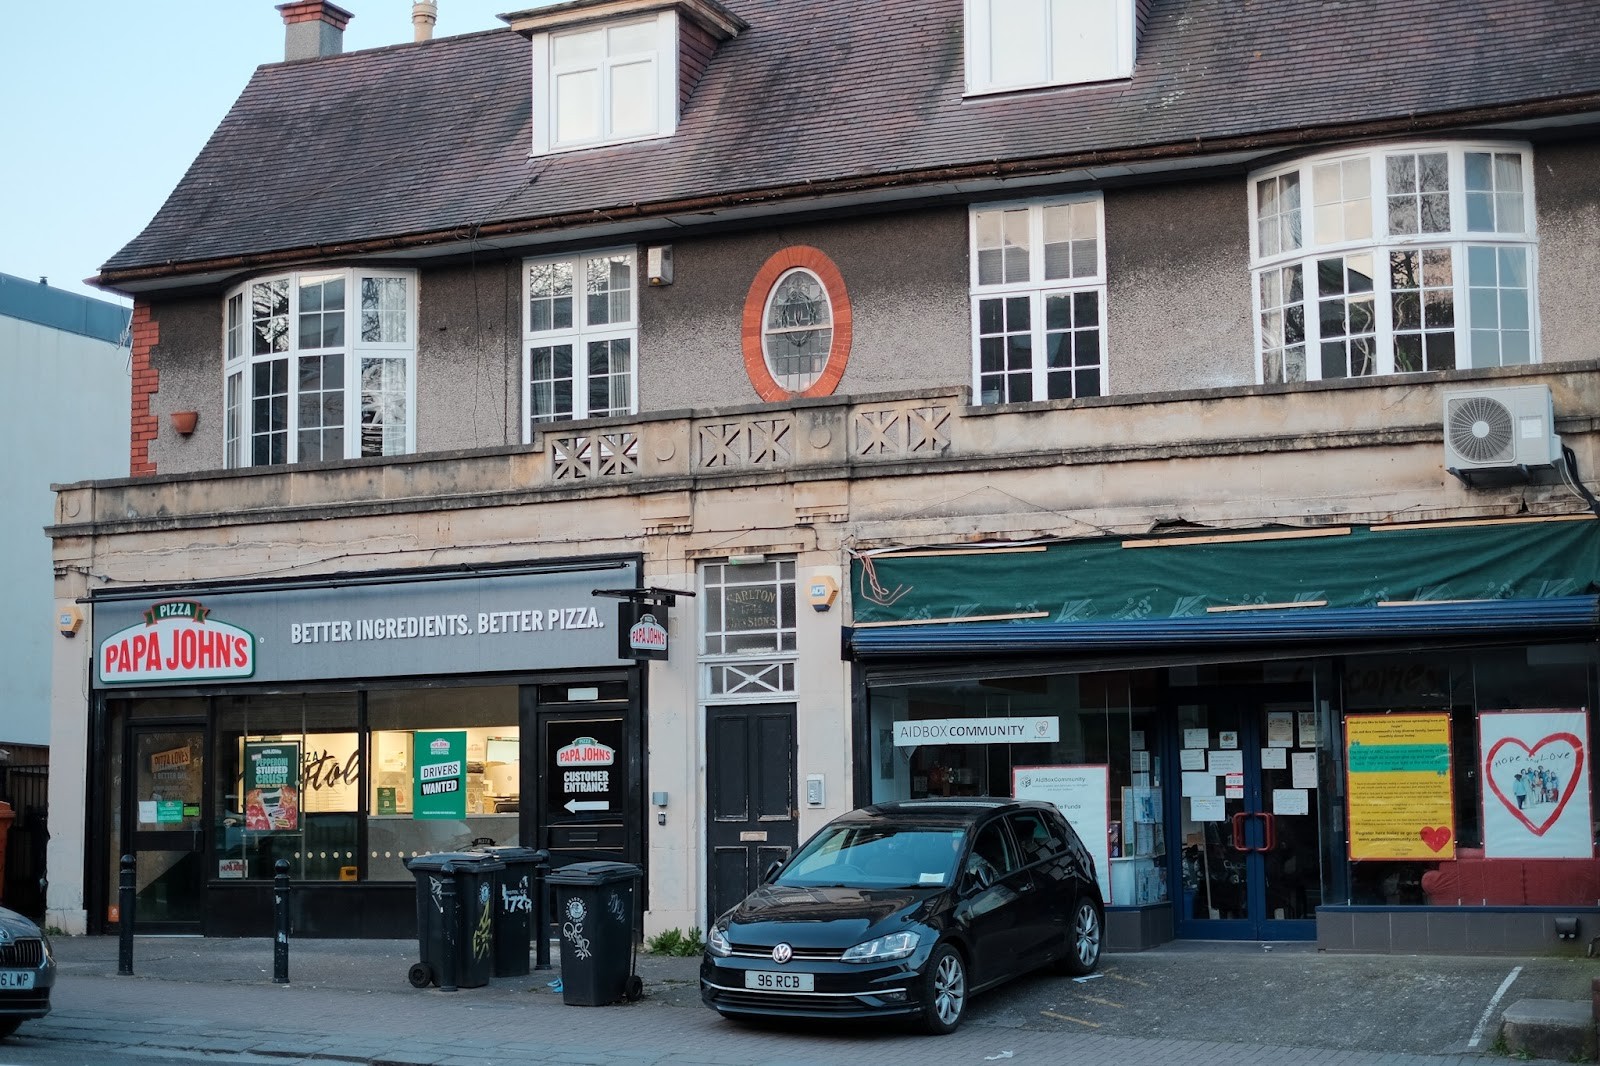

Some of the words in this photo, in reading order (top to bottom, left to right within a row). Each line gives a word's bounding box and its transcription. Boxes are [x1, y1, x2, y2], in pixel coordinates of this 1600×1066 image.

[726, 589, 776, 604] CARLTON
[160, 603, 191, 617] PIZZA
[291, 621, 353, 644] BETTER
[357, 614, 473, 641] INGREDIENTS.
[477, 610, 543, 634] BETTER
[548, 607, 604, 629] PIZZA.
[632, 627, 646, 644] PAPA
[105, 631, 162, 673] PAPA
[166, 629, 248, 670] JOHN'S
[256, 758, 288, 766] PEPPERONI
[560, 749, 581, 762] PAPA
[256, 766, 288, 774] STUFFED
[424, 764, 458, 778] DRIVERS
[564, 771, 609, 782] CUSTOMER
[256, 774, 288, 784] CRUST
[423, 780, 457, 795] WANTED
[564, 782, 609, 793] ENTRANCE
[757, 974, 773, 986] 96
[776, 975, 800, 988] RCB
